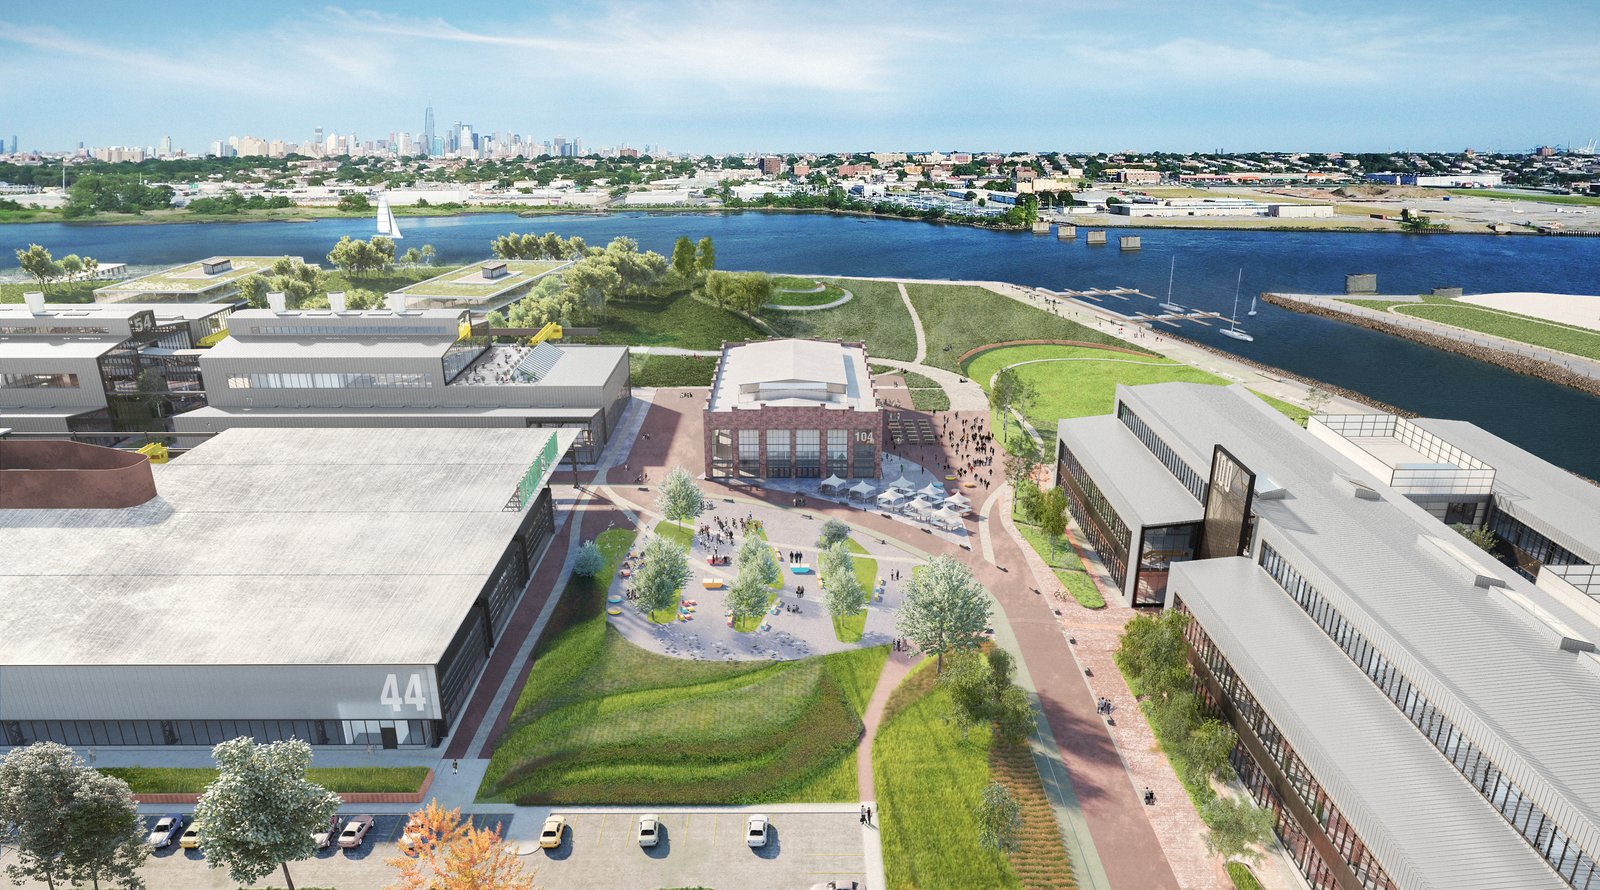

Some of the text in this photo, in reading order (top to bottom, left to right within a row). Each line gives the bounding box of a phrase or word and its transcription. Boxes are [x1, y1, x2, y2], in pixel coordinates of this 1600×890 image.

[134, 314, 151, 332] 54
[855, 431, 873, 442] 104
[1214, 450, 1232, 492] 100
[380, 673, 426, 712] 44
